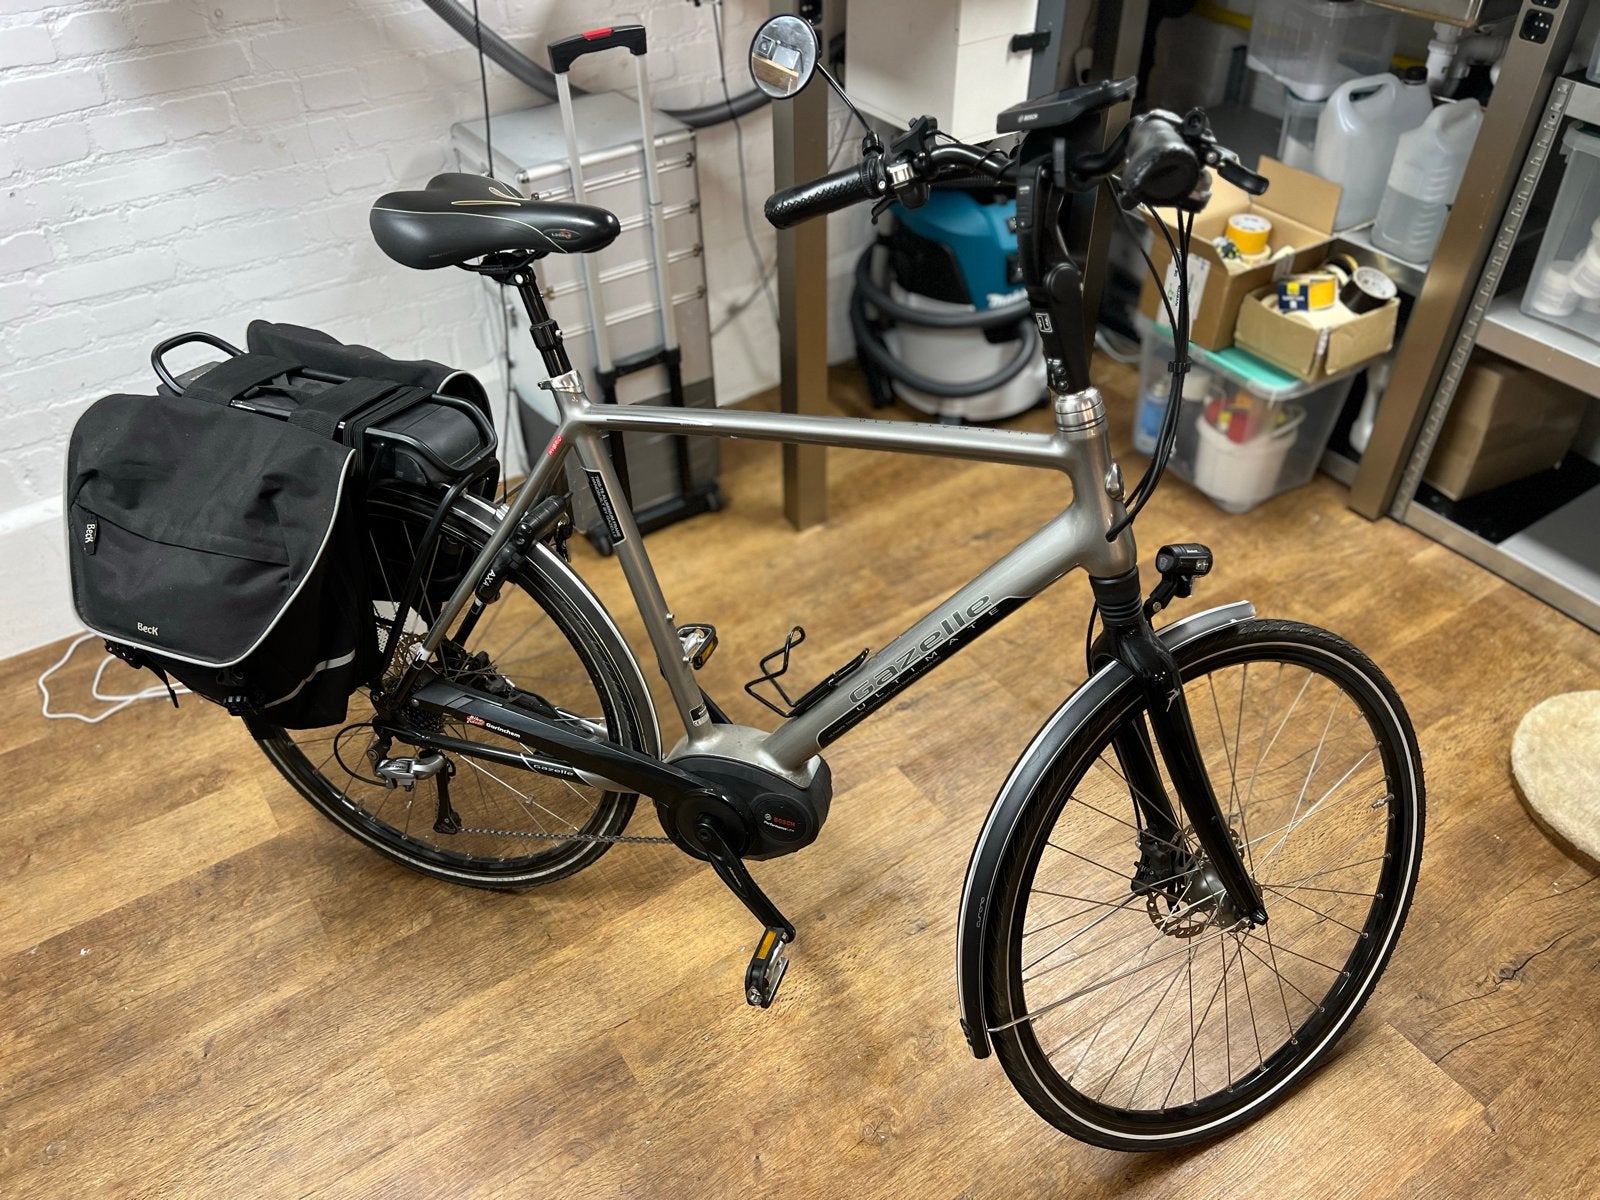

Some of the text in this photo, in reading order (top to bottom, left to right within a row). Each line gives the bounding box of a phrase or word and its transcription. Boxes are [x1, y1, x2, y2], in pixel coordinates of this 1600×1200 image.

[482, 569, 496, 586] AXA
[849, 594, 994, 704] Gazelle
[856, 606, 1000, 712] ULTIMATE
[533, 764, 574, 776] Gazelle
[773, 816, 796, 828] BOSCH
